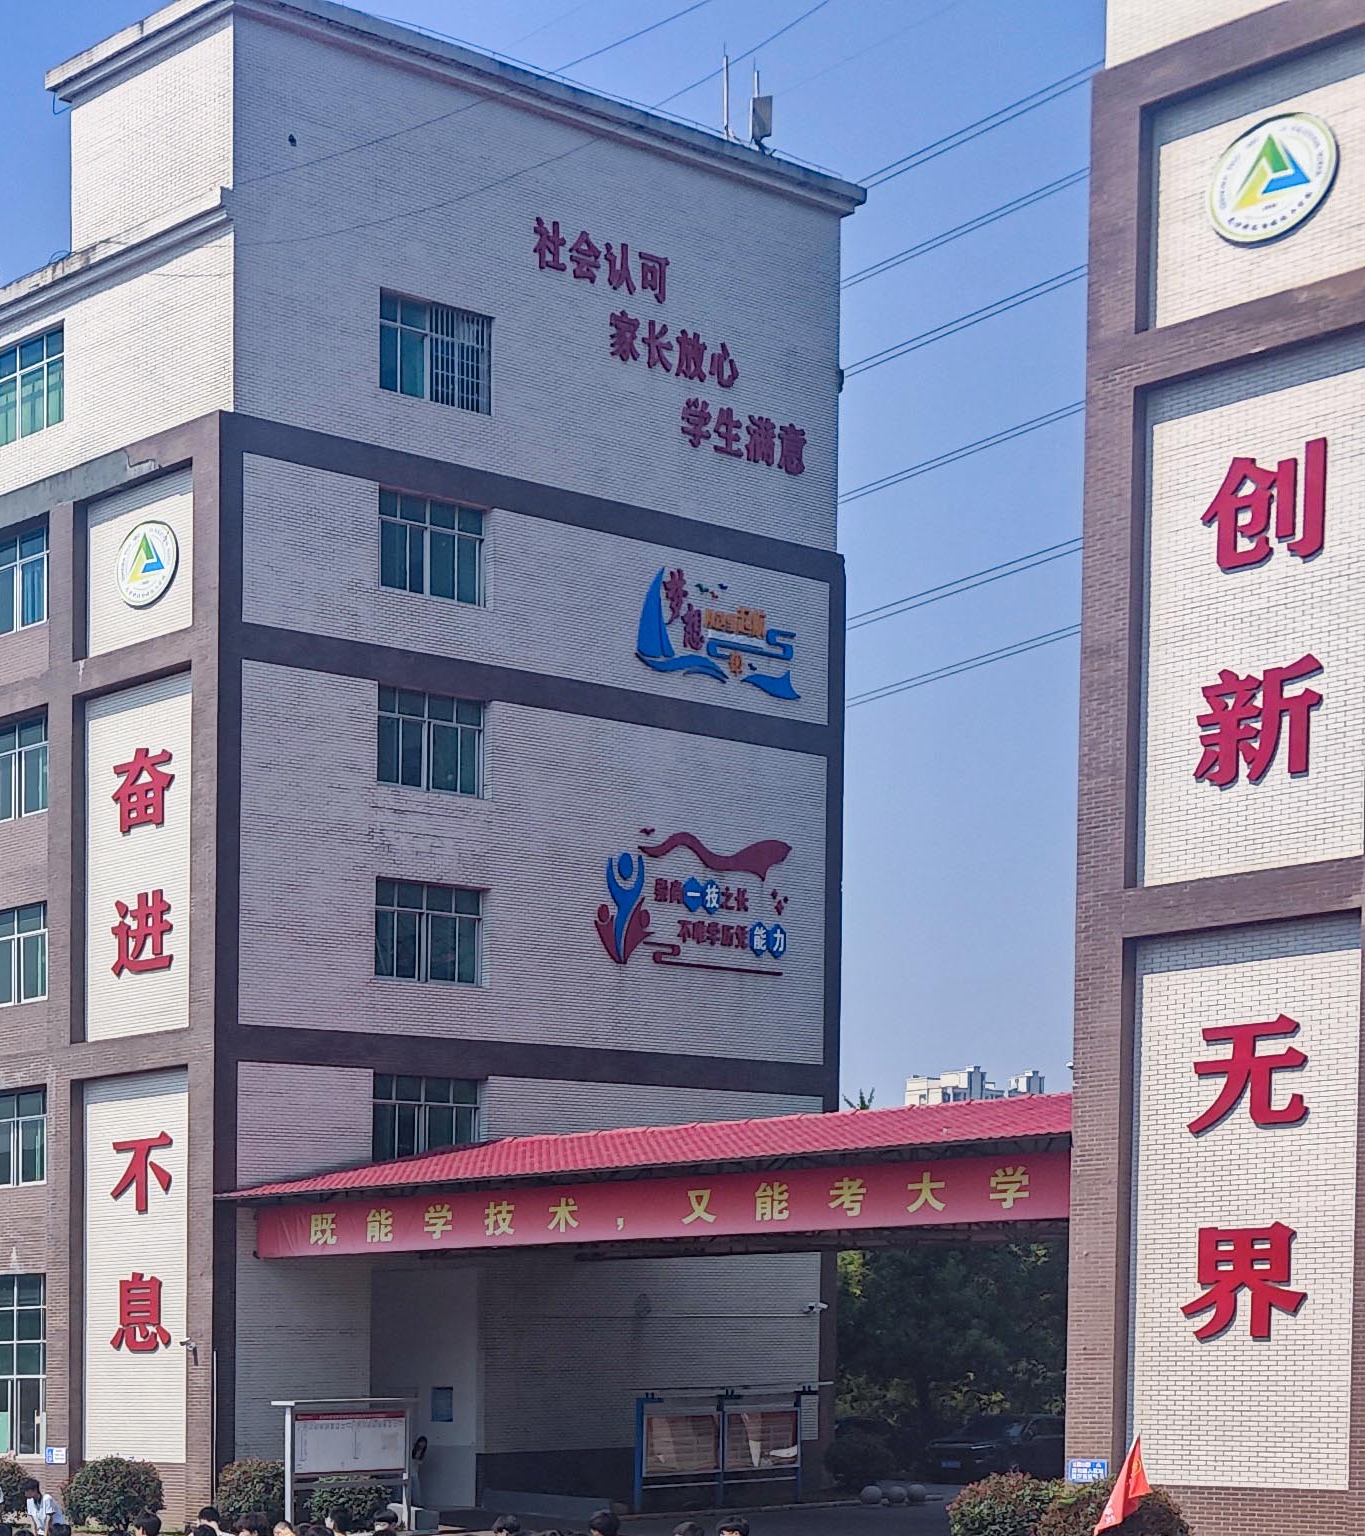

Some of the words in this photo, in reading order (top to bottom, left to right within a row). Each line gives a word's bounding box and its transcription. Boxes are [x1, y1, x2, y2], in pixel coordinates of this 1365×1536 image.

[533, 216, 670, 304] 社会认可
[609, 310, 739, 388] 家长放心
[681, 397, 807, 476] 学生满意
[308, 1166, 1031, 1246] 既能学技术，又能考大学
